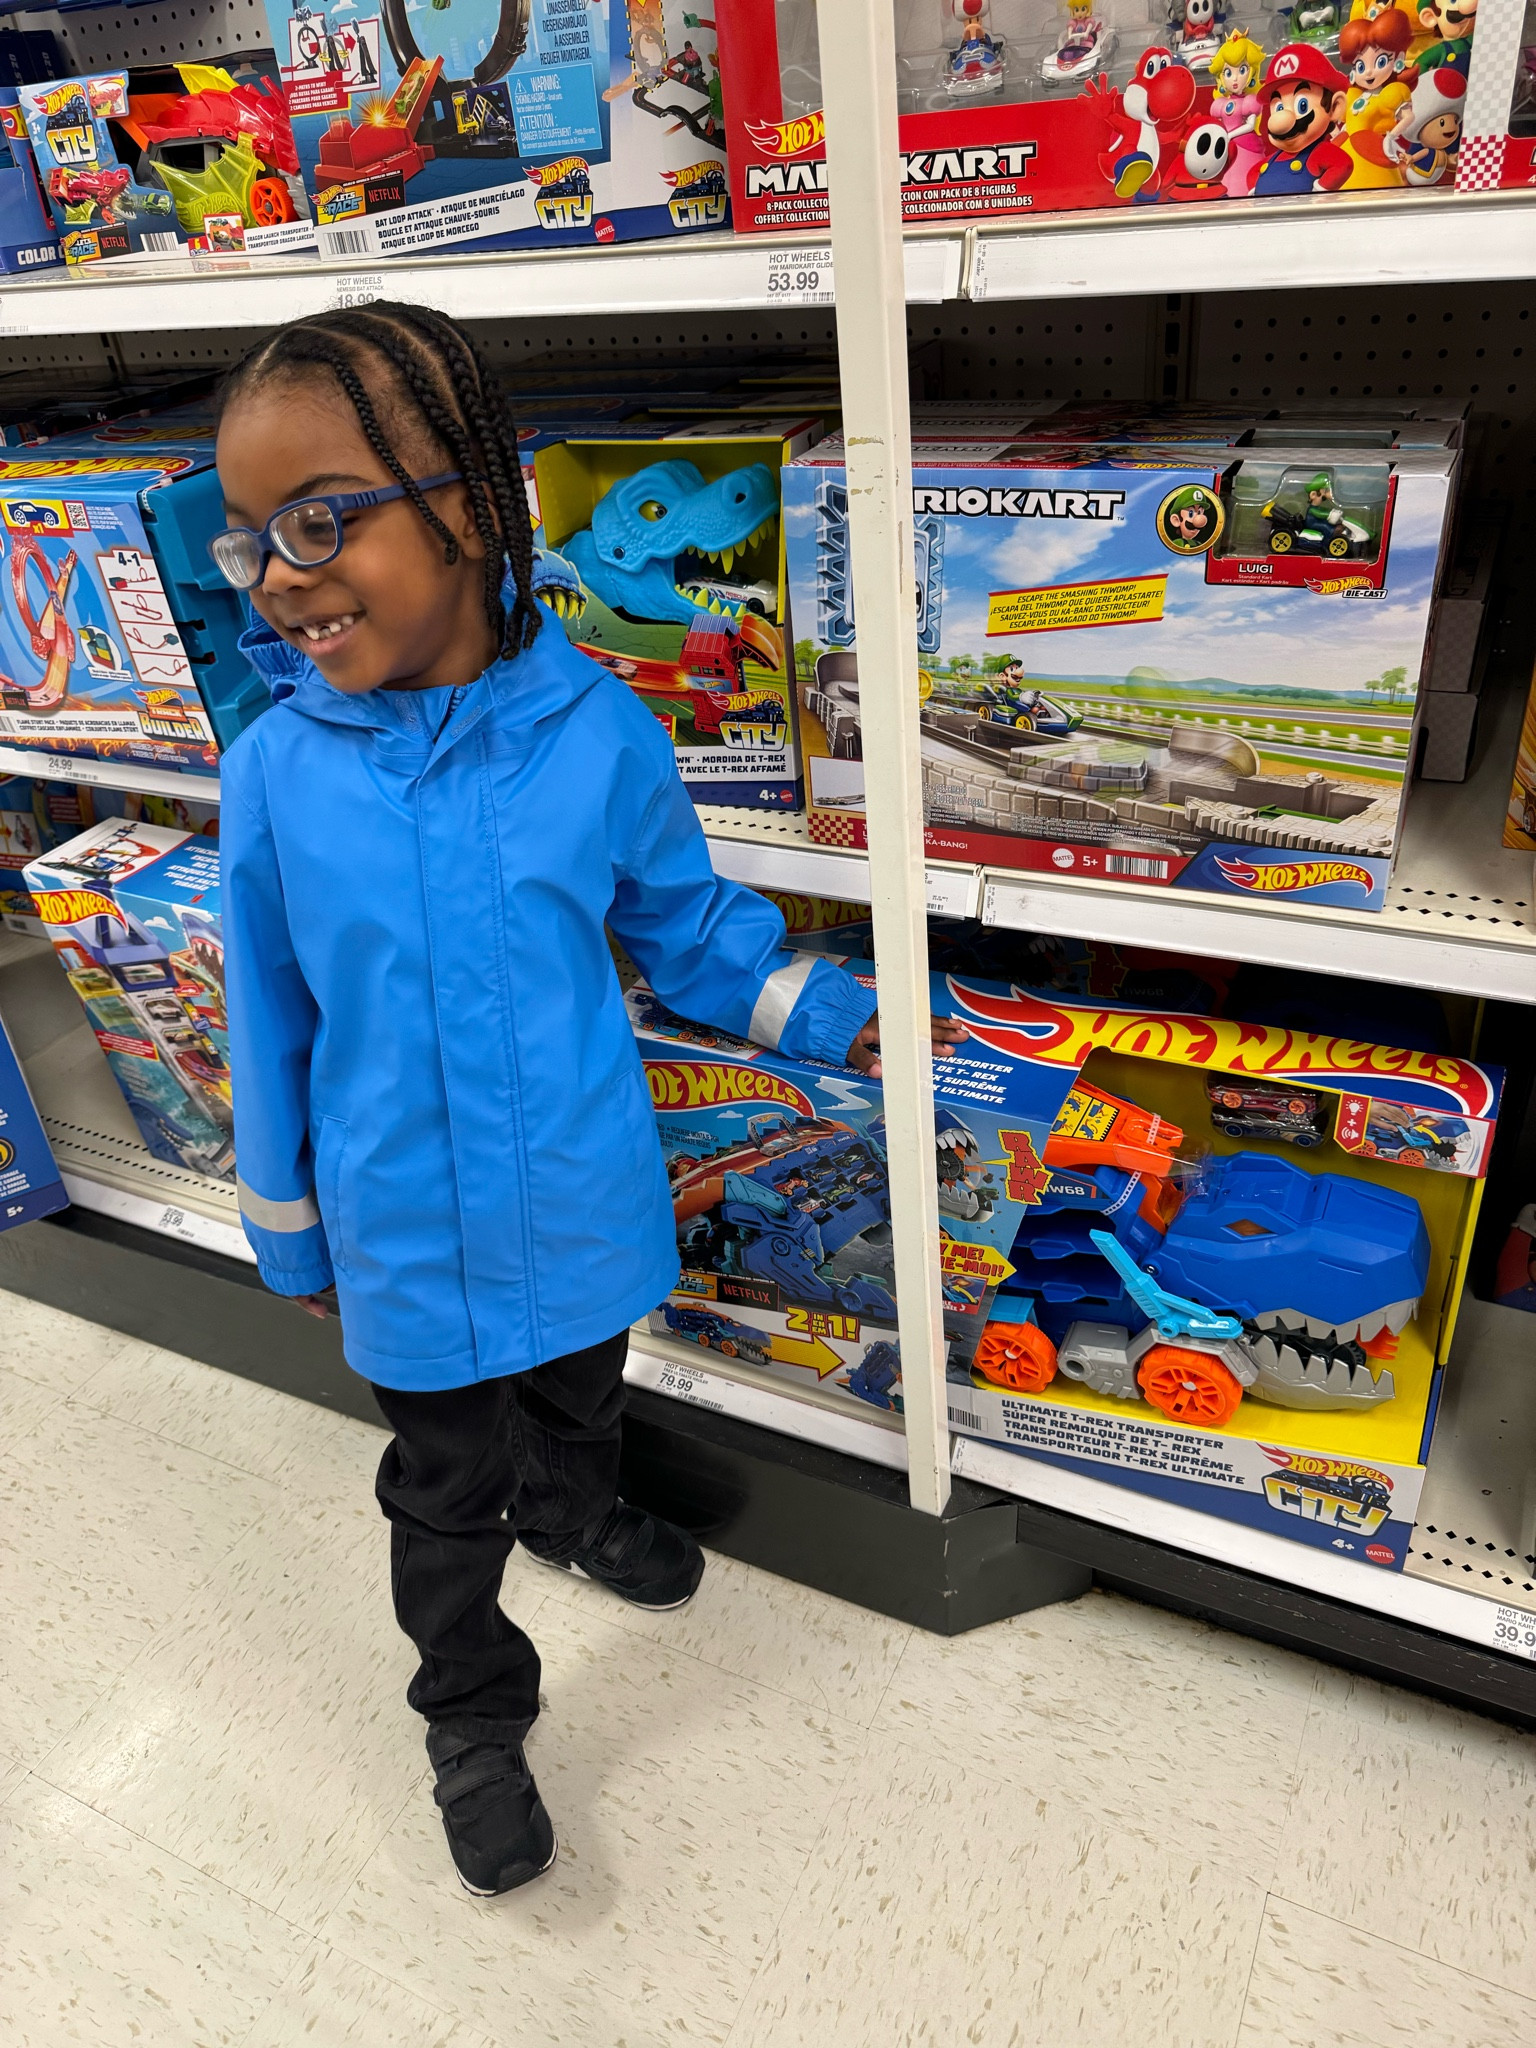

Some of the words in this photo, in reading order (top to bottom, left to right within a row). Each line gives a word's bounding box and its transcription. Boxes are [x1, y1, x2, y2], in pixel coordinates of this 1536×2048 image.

[368, 187, 400, 202] NETFLIX
[923, 188, 939, 200] CON
[941, 187, 961, 199] PACK
[962, 187, 973, 198] DE
[974, 186, 980, 197] 8
[981, 183, 1017, 196] FIGURAS
[327, 197, 362, 215] RACE
[375, 218, 387, 228] BAT
[388, 214, 406, 225] LOOP
[440, 201, 467, 214] ATAQUE
[468, 199, 478, 208] DE
[479, 188, 525, 206] MURCIÉLAGO
[535, 194, 592, 229] CITY
[668, 194, 727, 228] CITY
[766, 201, 792, 211] 8-PACK
[793, 198, 829, 210] COLLECTO
[905, 201, 964, 214] COLECIONADOR
[965, 199, 983, 210] COM
[984, 198, 990, 209] 8
[991, 196, 1033, 208] UNIDADES
[378, 226, 403, 239] BOUCLE
[404, 224, 413, 233] ET
[413, 217, 444, 232] ATTAQUE
[444, 206, 500, 225] CHAUVE-SOURIS
[754, 214, 785, 225] COFFRET
[280, 227, 309, 236] TRANSPORTER
[381, 237, 407, 250] ATAQUE
[406, 235, 416, 245] DE
[417, 232, 435, 243] LOOP
[436, 229, 445, 239] DE
[446, 222, 480, 237] MORCEGO
[595, 225, 615, 239] MATTEL
[101, 236, 127, 248] NETFLIX
[248, 240, 279, 250] TRANSPORTEUR
[17, 247, 56, 265] COLOR
[769, 253, 790, 263] HOT
[791, 251, 830, 262] WHEELS
[779, 262, 815, 271] MARIOKART
[337, 277, 351, 286] HOT
[353, 276, 382, 286] WHEELS
[767, 271, 820, 292] 53.99
[337, 293, 375, 310] 1899
[912, 487, 1126, 519] RIOKART
[118, 551, 141, 567] 4-1
[1238, 563, 1274, 574] LUIGI
[990, 604, 1020, 616] ¡ESCAPA
[1020, 603, 1034, 612] DEL
[1035, 599, 1068, 610] THWOMP
[1068, 598, 1083, 608] QUE
[1084, 595, 1112, 606] QUIERE
[1113, 590, 1163, 603] APLASTARTE!
[1017, 592, 1045, 604] ESCAPE
[1045, 591, 1060, 601] THE
[1060, 588, 1099, 600] SMASHING
[1100, 584, 1137, 596] THWOMP!
[1345, 590, 1385, 598] DIE-CAST
[1000, 611, 1048, 622] SAUVEZ-VOUS
[1049, 609, 1060, 617] DU
[1061, 605, 1093, 616] KA-BANG
[1094, 600, 1150, 613] DESTRUCTEUR!
[1009, 619, 1036, 629] ESCAPE
[1036, 617, 1047, 626] DA
[1047, 615, 1088, 625] ESMAGADO
[1089, 613, 1100, 621] DO
[1101, 610, 1137, 620] THWOMP!
[726, 694, 749, 711] HOT
[139, 713, 208, 741] BUILDER
[719, 721, 787, 752] CITY
[48, 757, 73, 771] 24.99
[702, 755, 743, 764] MORDIDA
[745, 755, 756, 763] DE
[758, 754, 786, 763] T-REX
[686, 766, 708, 774] AVEC
[710, 766, 721, 774] LE
[722, 765, 749, 774] T-REX
[750, 763, 787, 773] AFFAMÉ
[759, 789, 778, 801] 4+
[925, 838, 968, 850] KA-BANG!
[1052, 854, 1075, 862] MATTEL
[1082, 855, 1099, 867] 5+
[1250, 866, 1298, 891] HOT
[1294, 863, 1367, 889] WHEELS
[32, 892, 70, 924] HOT
[1033, 1007, 1208, 1063] HOT
[940, 1064, 954, 1074] DE
[979, 1071, 1000, 1082] REX
[942, 1076, 1007, 1094] SUPRÊME
[941, 1086, 1007, 1105] ULTIMATE
[1000, 1131, 1051, 1204] RAWR
[6, 1204, 25, 1218] 5+
[951, 1243, 985, 1262] ME!
[940, 1258, 1005, 1278] IE-MOI!
[722, 1283, 772, 1305] NETFLIX
[786, 1306, 811, 1332] 2
[813, 1313, 824, 1321] IN
[813, 1320, 826, 1328] EN
[812, 1326, 827, 1335] EM
[827, 1314, 857, 1341] 1!
[665, 1362, 679, 1371] HOT
[679, 1366, 705, 1379] WHEELS
[659, 1372, 693, 1392] 79.99
[1001, 1399, 1068, 1420] ULTIMATE
[1071, 1412, 1114, 1429] T-REX
[1116, 1421, 1224, 1450] TRANSPORTER
[1002, 1408, 1047, 1426] SÚPER
[1050, 1419, 1126, 1442] REMOLQUE
[1129, 1434, 1149, 1446] DE
[1171, 1443, 1202, 1456] REX
[1003, 1419, 1111, 1448] TRANSPORTEUR
[1113, 1441, 1159, 1458] T-REX
[1160, 1450, 1234, 1473] SUPRÊME
[1004, 1429, 1121, 1461] TRANSPORTADOR
[1123, 1453, 1168, 1471] T-REX
[1171, 1463, 1246, 1485] ULTIMATE
[1289, 1453, 1327, 1475] HOT
[1262, 1477, 1391, 1537] CITY
[1331, 1538, 1355, 1551] 4+
[1365, 1549, 1396, 1560] MATTEL
[1497, 1606, 1519, 1619] HOT
[1496, 1614, 1517, 1625] MARIO
[1517, 1621, 1535, 1631] KART
[1494, 1622, 1536, 1647] 39.9
